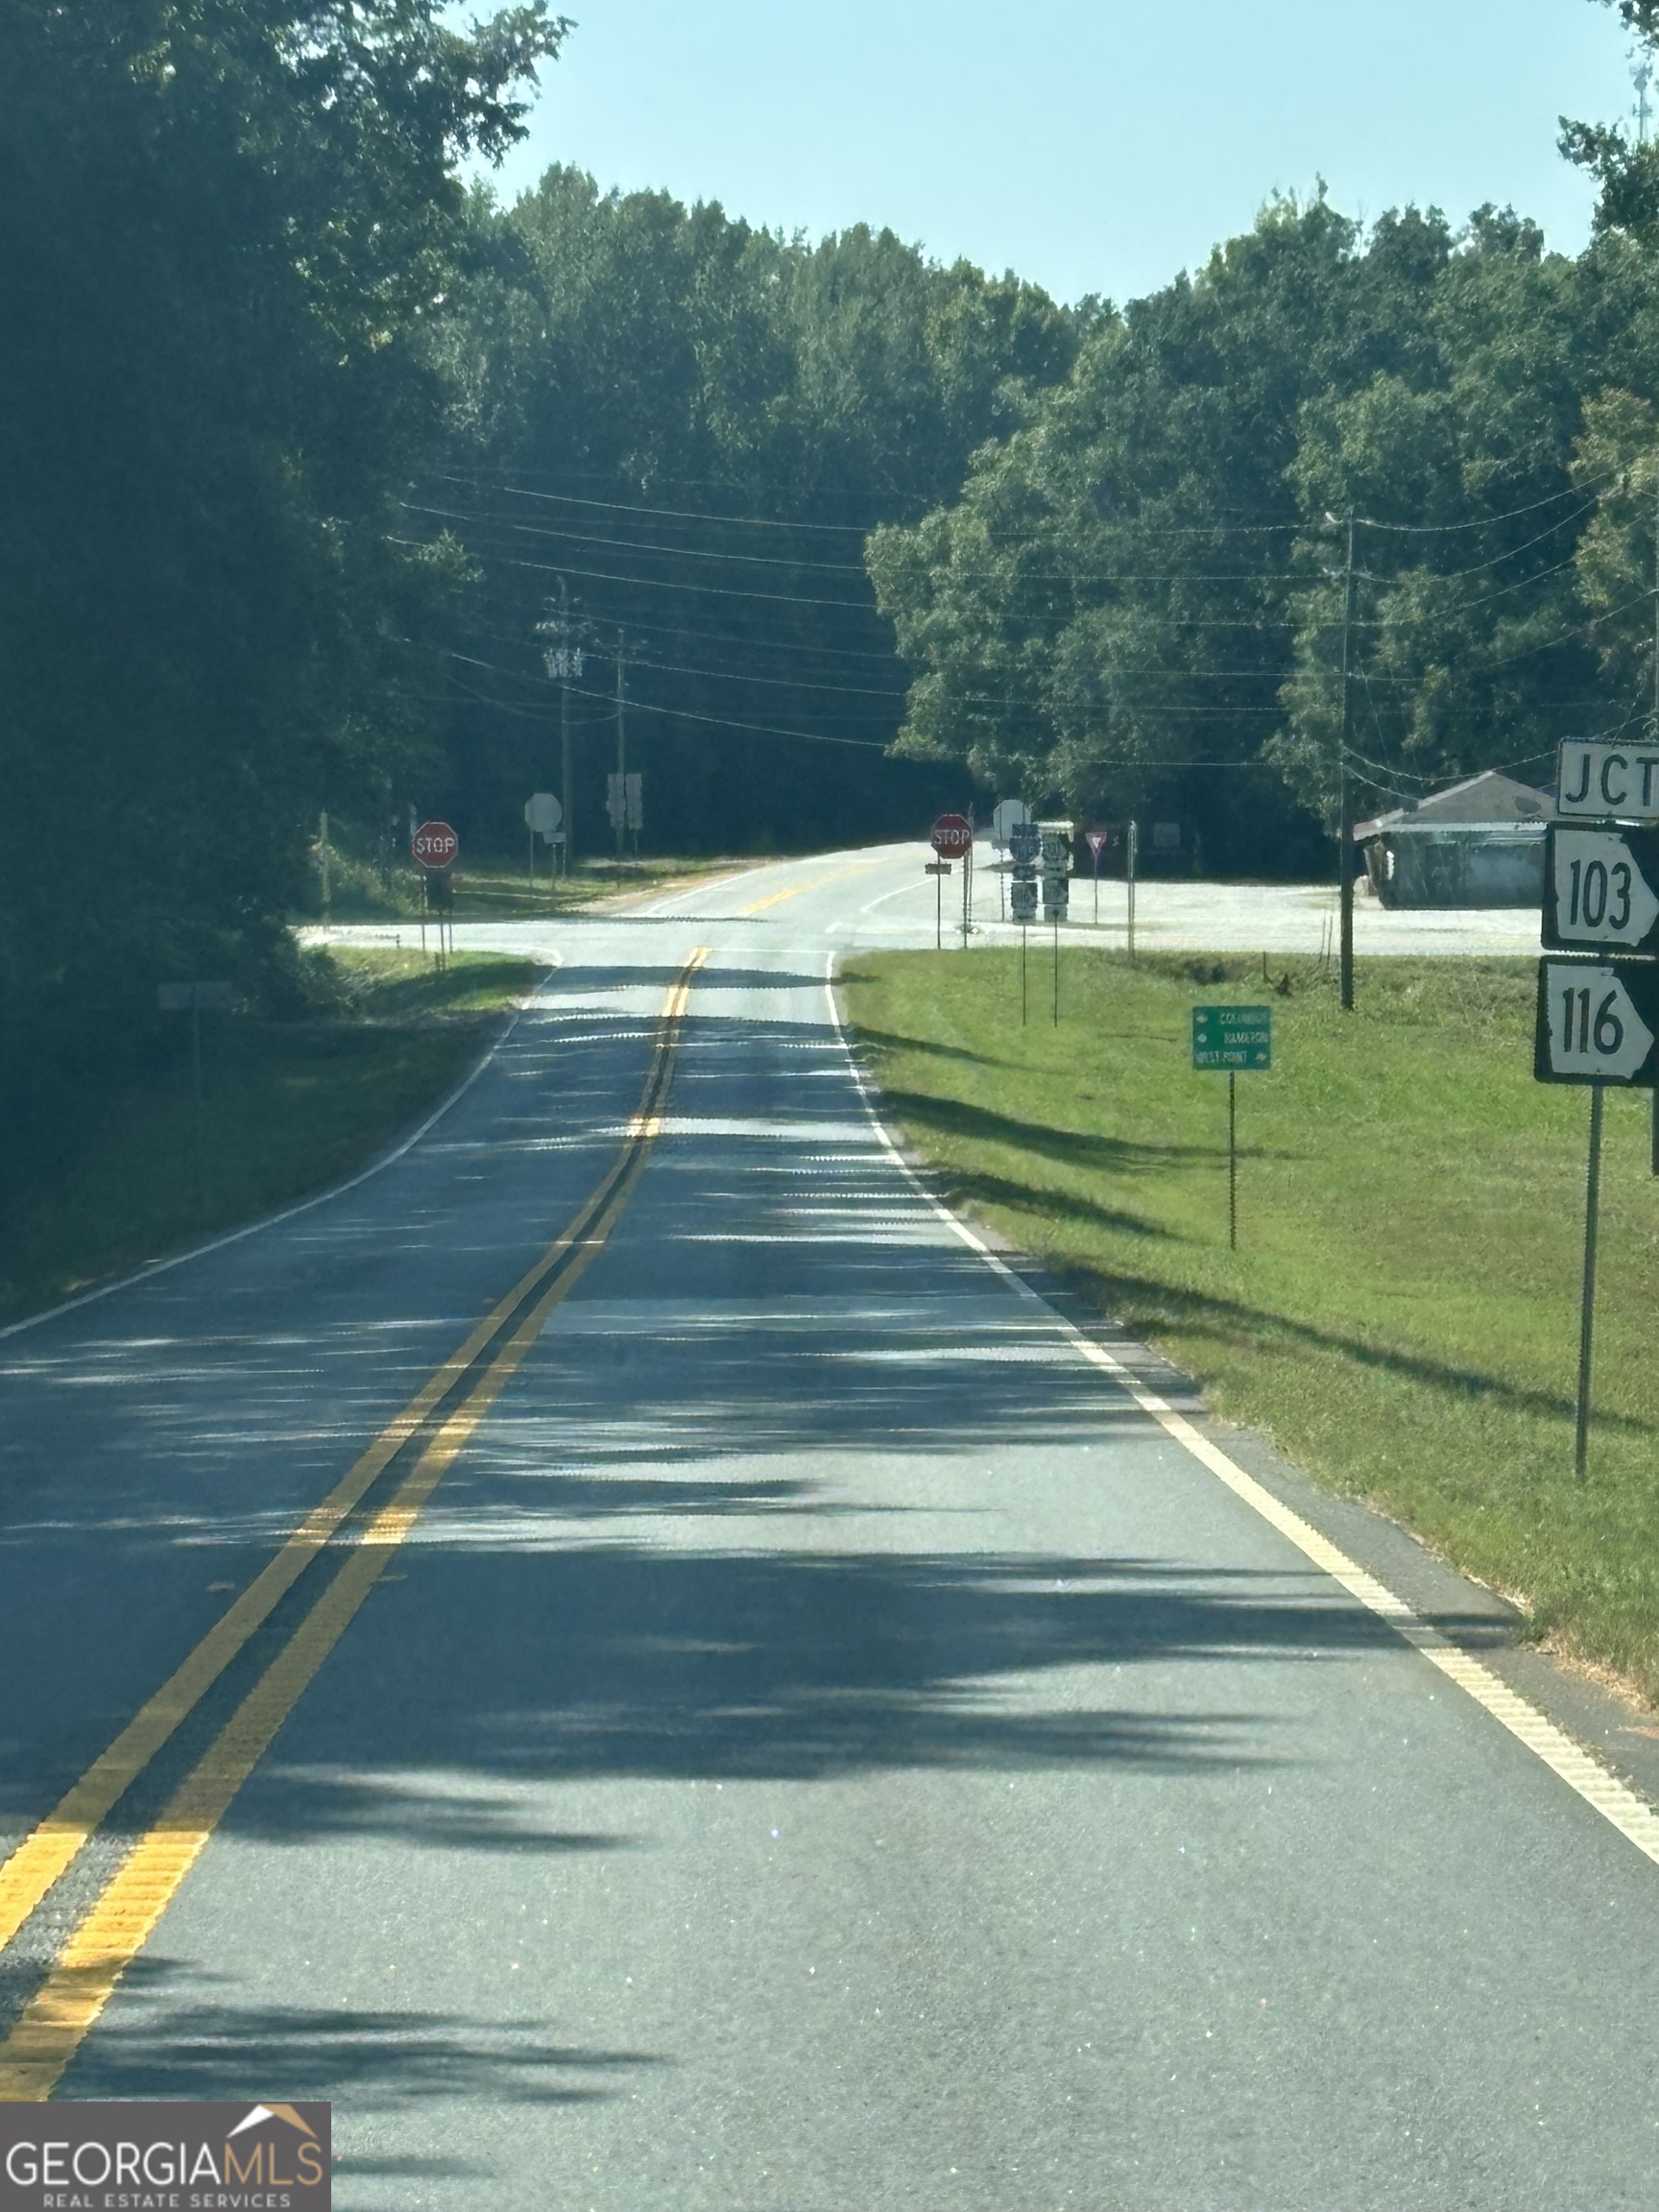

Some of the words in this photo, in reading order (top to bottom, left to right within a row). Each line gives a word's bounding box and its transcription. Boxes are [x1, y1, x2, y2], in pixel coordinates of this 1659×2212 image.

[1565, 754, 1659, 807] JCT
[417, 837, 455, 854] STOP
[934, 829, 971, 845] STOP
[1570, 859, 1632, 930] 103
[1562, 986, 1624, 1055] 116
